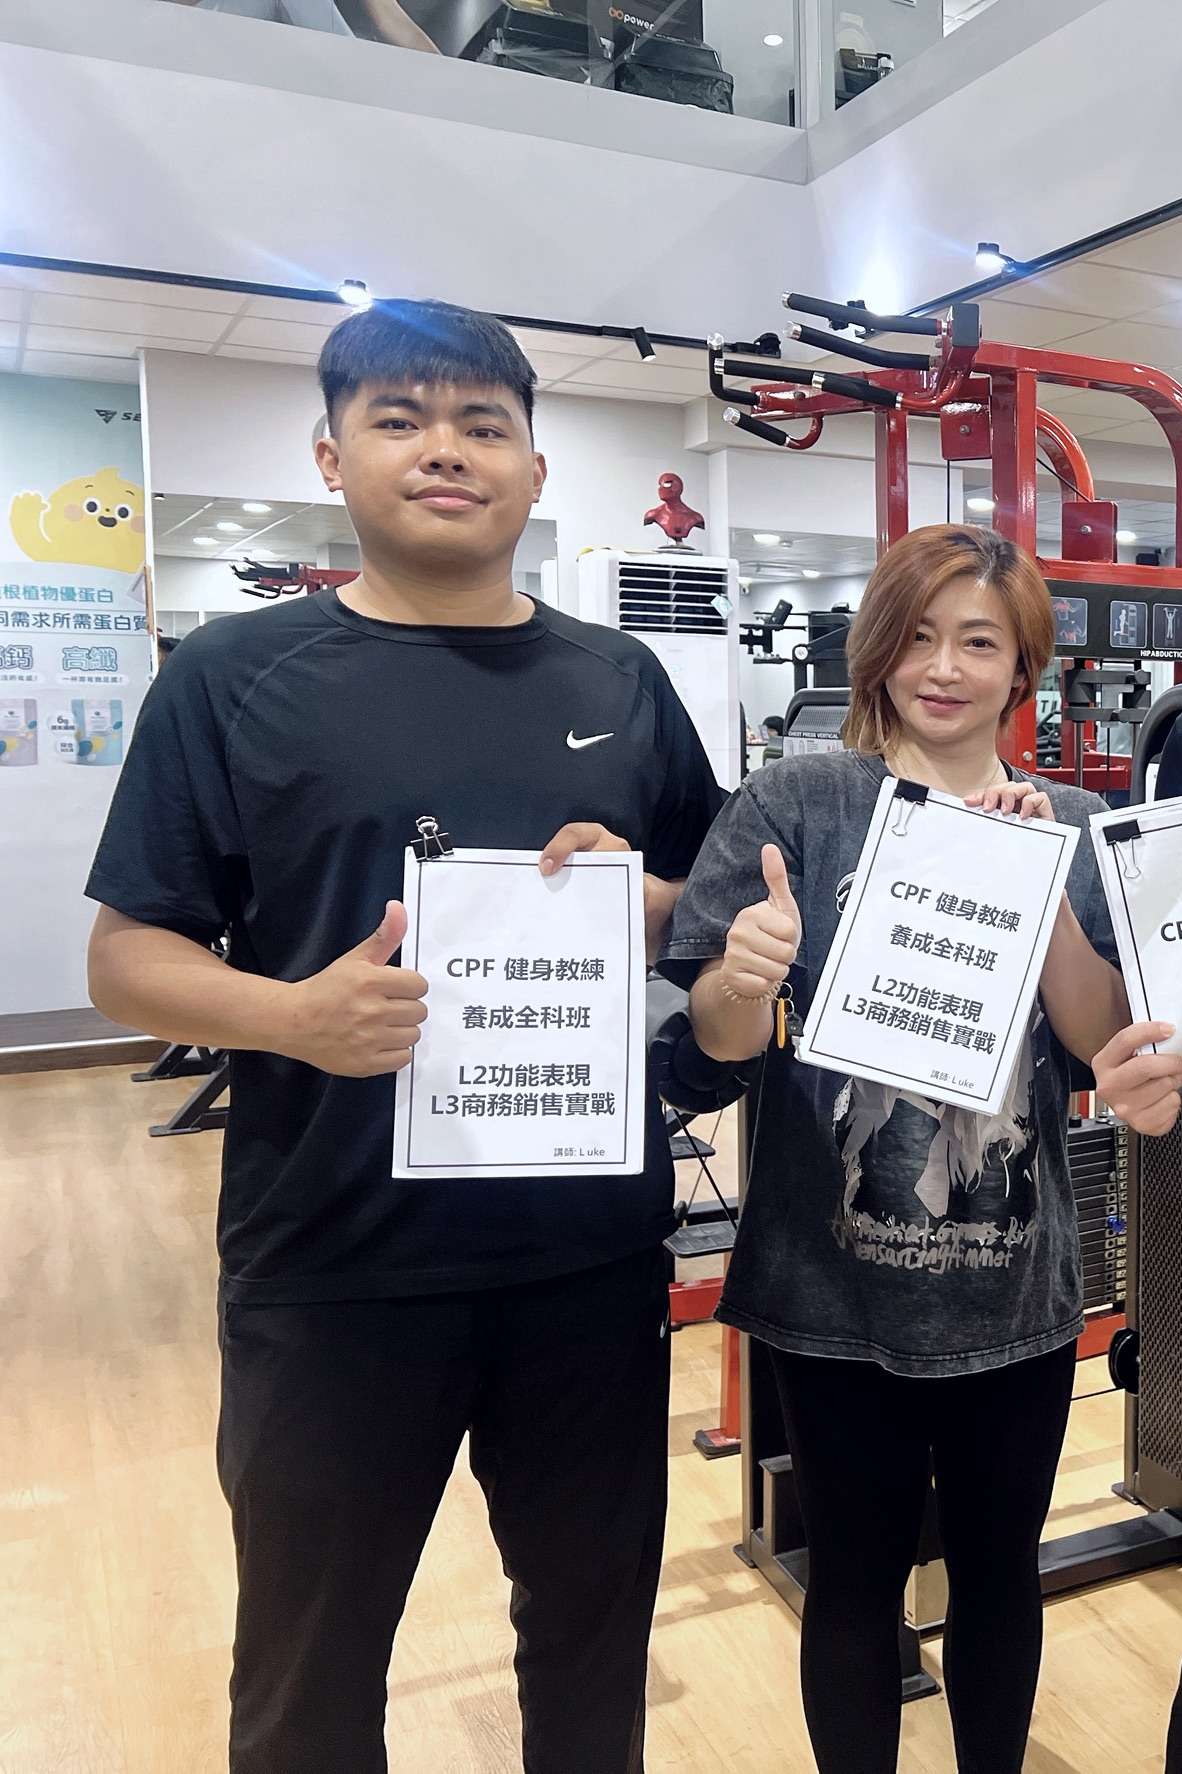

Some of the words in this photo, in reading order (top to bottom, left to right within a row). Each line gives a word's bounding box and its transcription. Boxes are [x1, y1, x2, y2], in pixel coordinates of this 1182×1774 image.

[0, 584, 113, 603] 根植物優蛋白
[890, 881, 932, 905] CPF
[935, 891, 1022, 933] 健身教練
[890, 924, 999, 972] 養成全科班
[446, 958, 495, 978] CPF
[503, 957, 605, 982] 健身教練
[871, 974, 984, 1023] L2功能表現
[462, 1005, 591, 1029] 養成全科班
[841, 994, 997, 1055] L3商務銷售實戰
[459, 1063, 591, 1088] L2功能表現
[431, 1091, 616, 1118] L3商務銷售實戰
